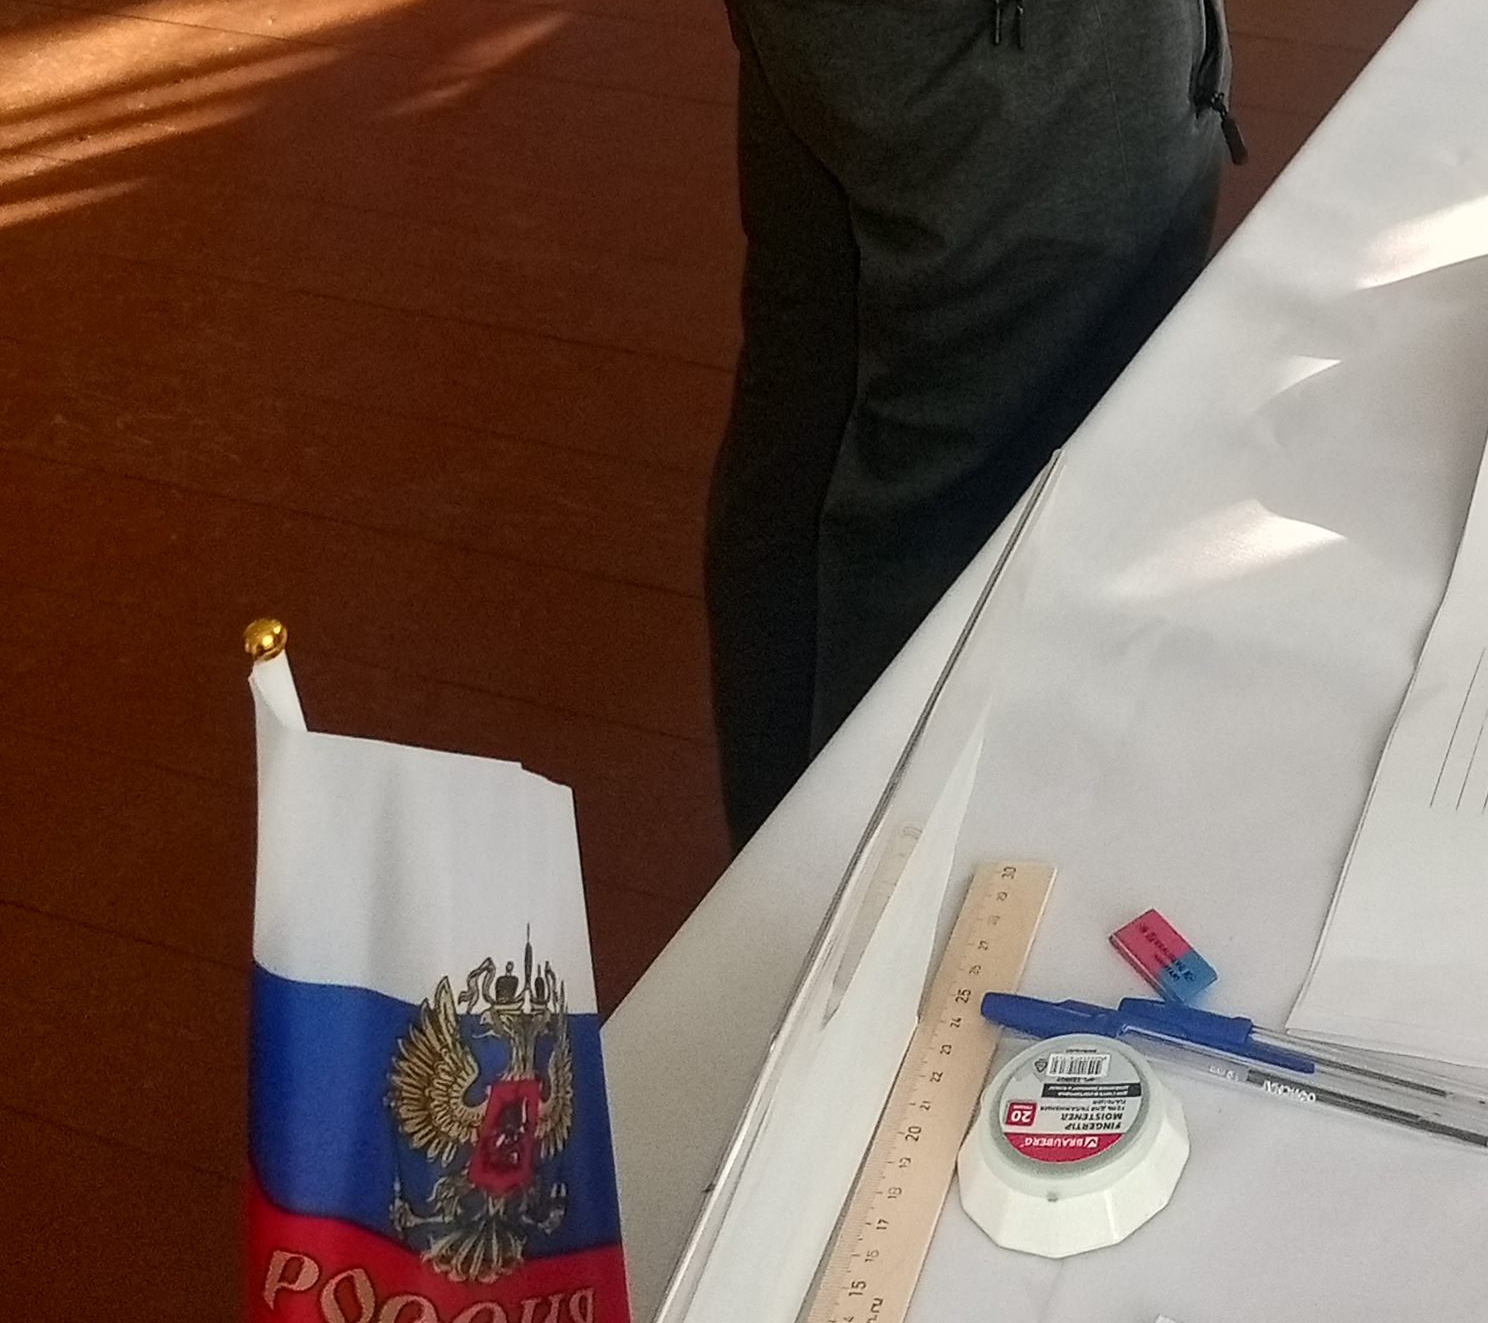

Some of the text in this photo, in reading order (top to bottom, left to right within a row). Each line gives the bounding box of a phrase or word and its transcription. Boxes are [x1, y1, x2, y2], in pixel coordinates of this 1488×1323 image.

[1002, 866, 1017, 879] 30
[955, 989, 972, 1004] 25
[950, 1017, 962, 1028] 24
[930, 1071, 944, 1083] 22
[919, 1100, 931, 1111] 21
[1011, 1111, 1032, 1122] 20
[1060, 1113, 1123, 1121] MOISTENER
[1064, 1122, 1122, 1130] FINGERTIP
[905, 1125, 923, 1142] 20
[1025, 1137, 1084, 1147] BRAUBERG
[876, 1218, 890, 1230] 17
[848, 1280, 868, 1296] 15
